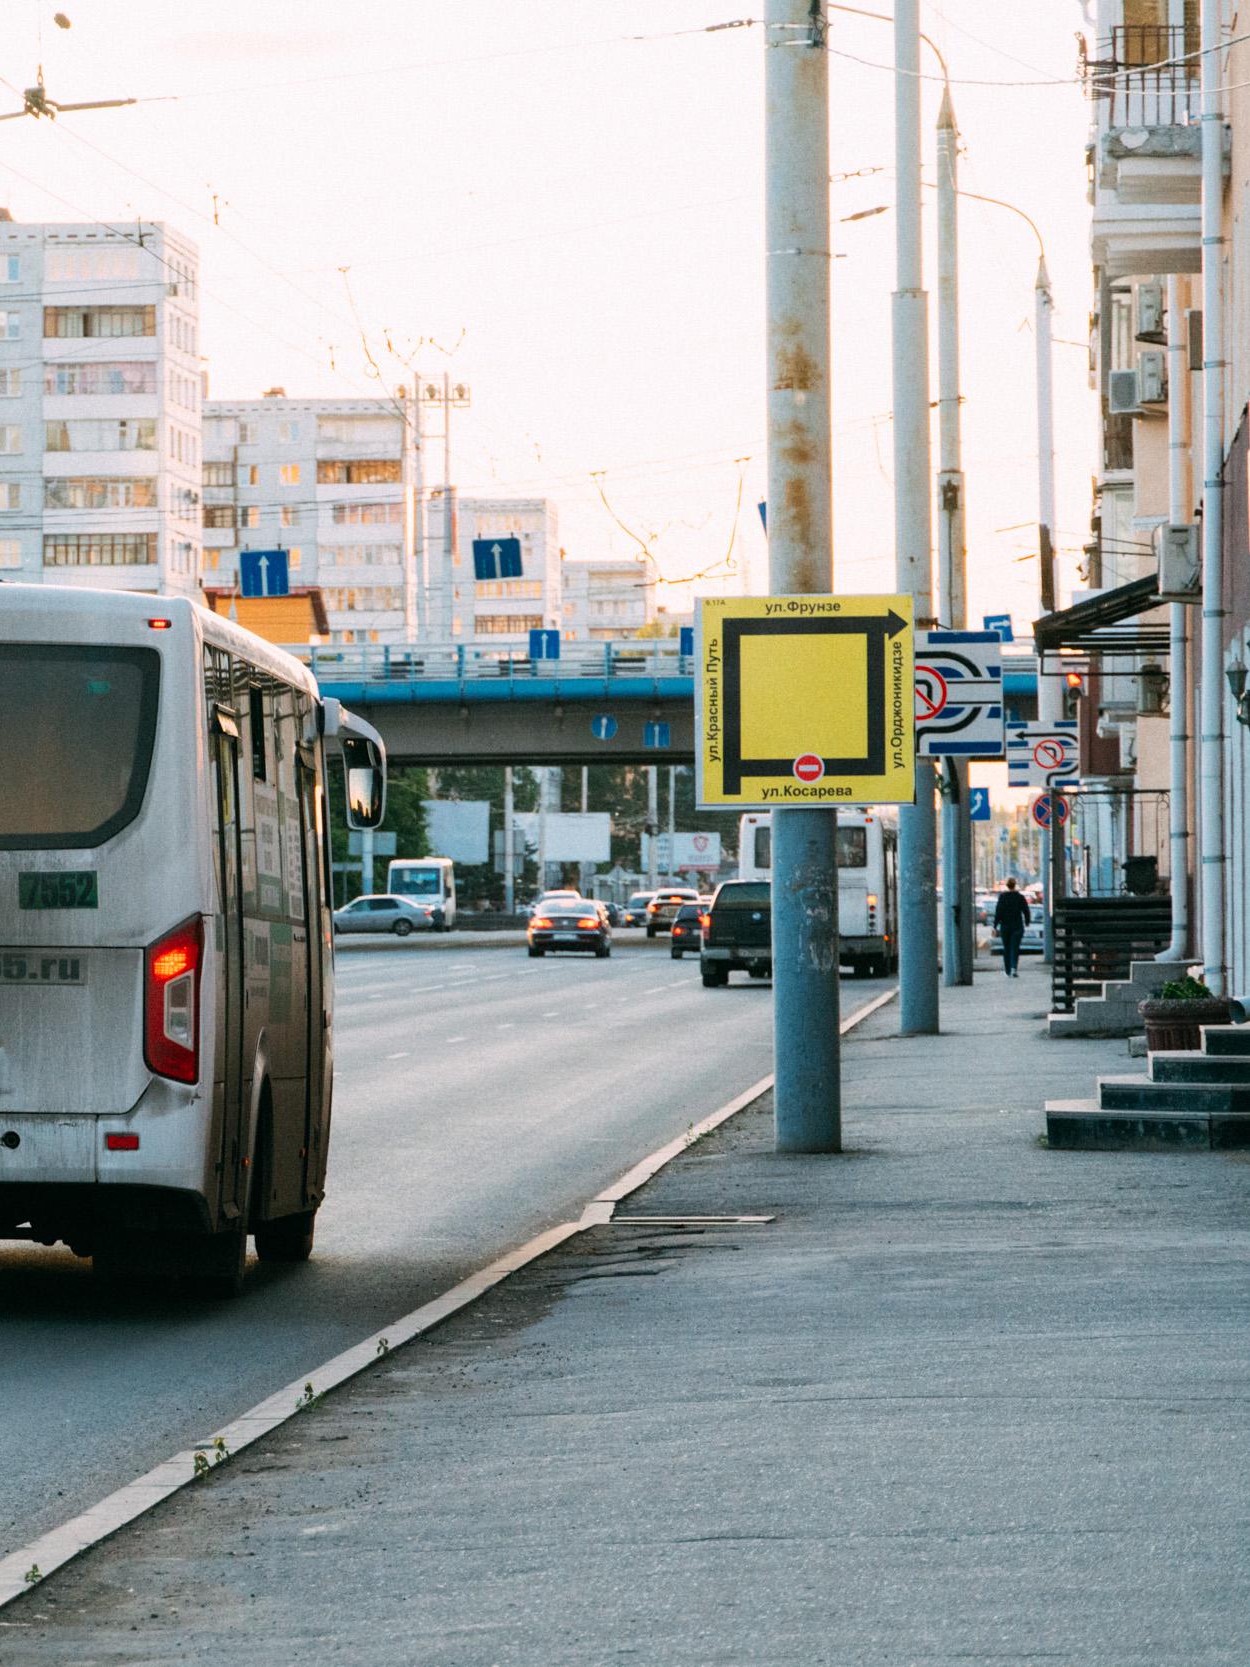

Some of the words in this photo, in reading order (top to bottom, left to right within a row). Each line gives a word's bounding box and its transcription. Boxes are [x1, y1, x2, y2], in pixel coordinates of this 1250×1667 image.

[765, 601, 842, 615] ул.Фрунзе
[706, 638, 721, 673] Путь
[706, 677, 721, 762] ул.Красный
[890, 641, 906, 769] ул.Орджоникидзе
[761, 785, 853, 800] ул.Косарева
[26, 871, 95, 908] 7552
